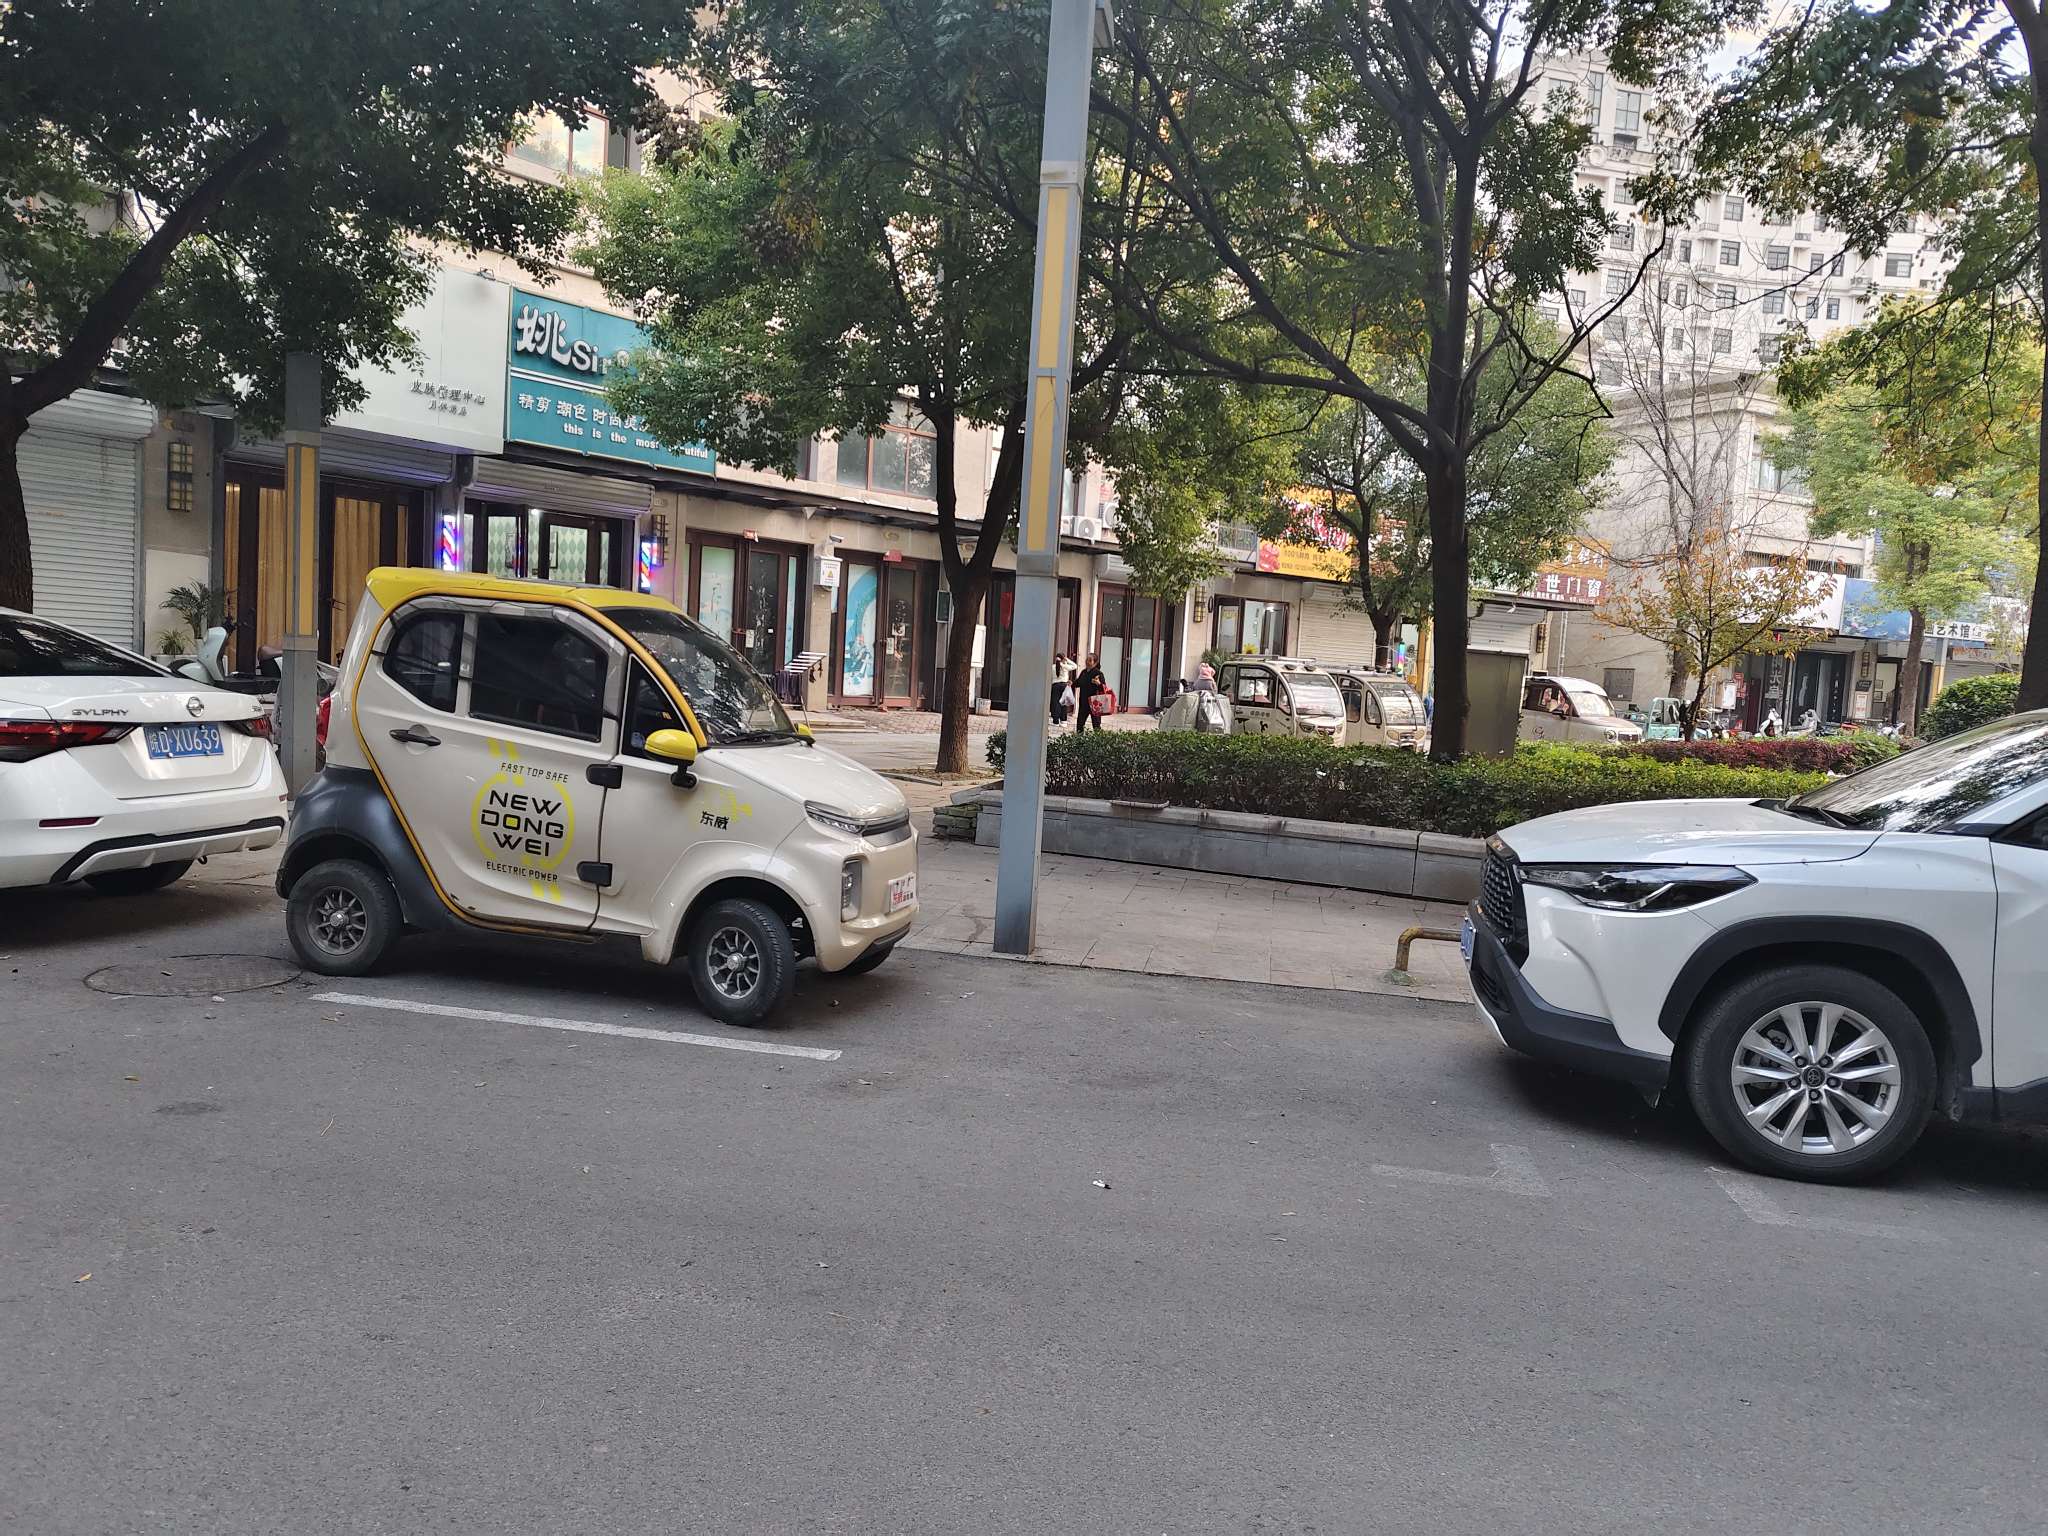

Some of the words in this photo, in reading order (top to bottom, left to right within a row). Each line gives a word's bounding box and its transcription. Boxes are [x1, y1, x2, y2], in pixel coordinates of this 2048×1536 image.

[518, 393, 551, 413] 精剪
[556, 400, 588, 422] 潮色
[563, 422, 583, 436] this
[592, 427, 602, 439] is
[610, 431, 628, 444] the
[71, 708, 129, 717] SYLPHY
[500, 762, 525, 775] FAST
[527, 767, 544, 778] TOP
[545, 771, 569, 783] SAFE
[489, 789, 562, 816] NEW
[480, 809, 564, 839] DONG
[700, 811, 729, 830] 东威
[492, 832, 550, 857] WEI
[486, 861, 527, 877] ELECTRIC
[529, 869, 559, 883] POWER
